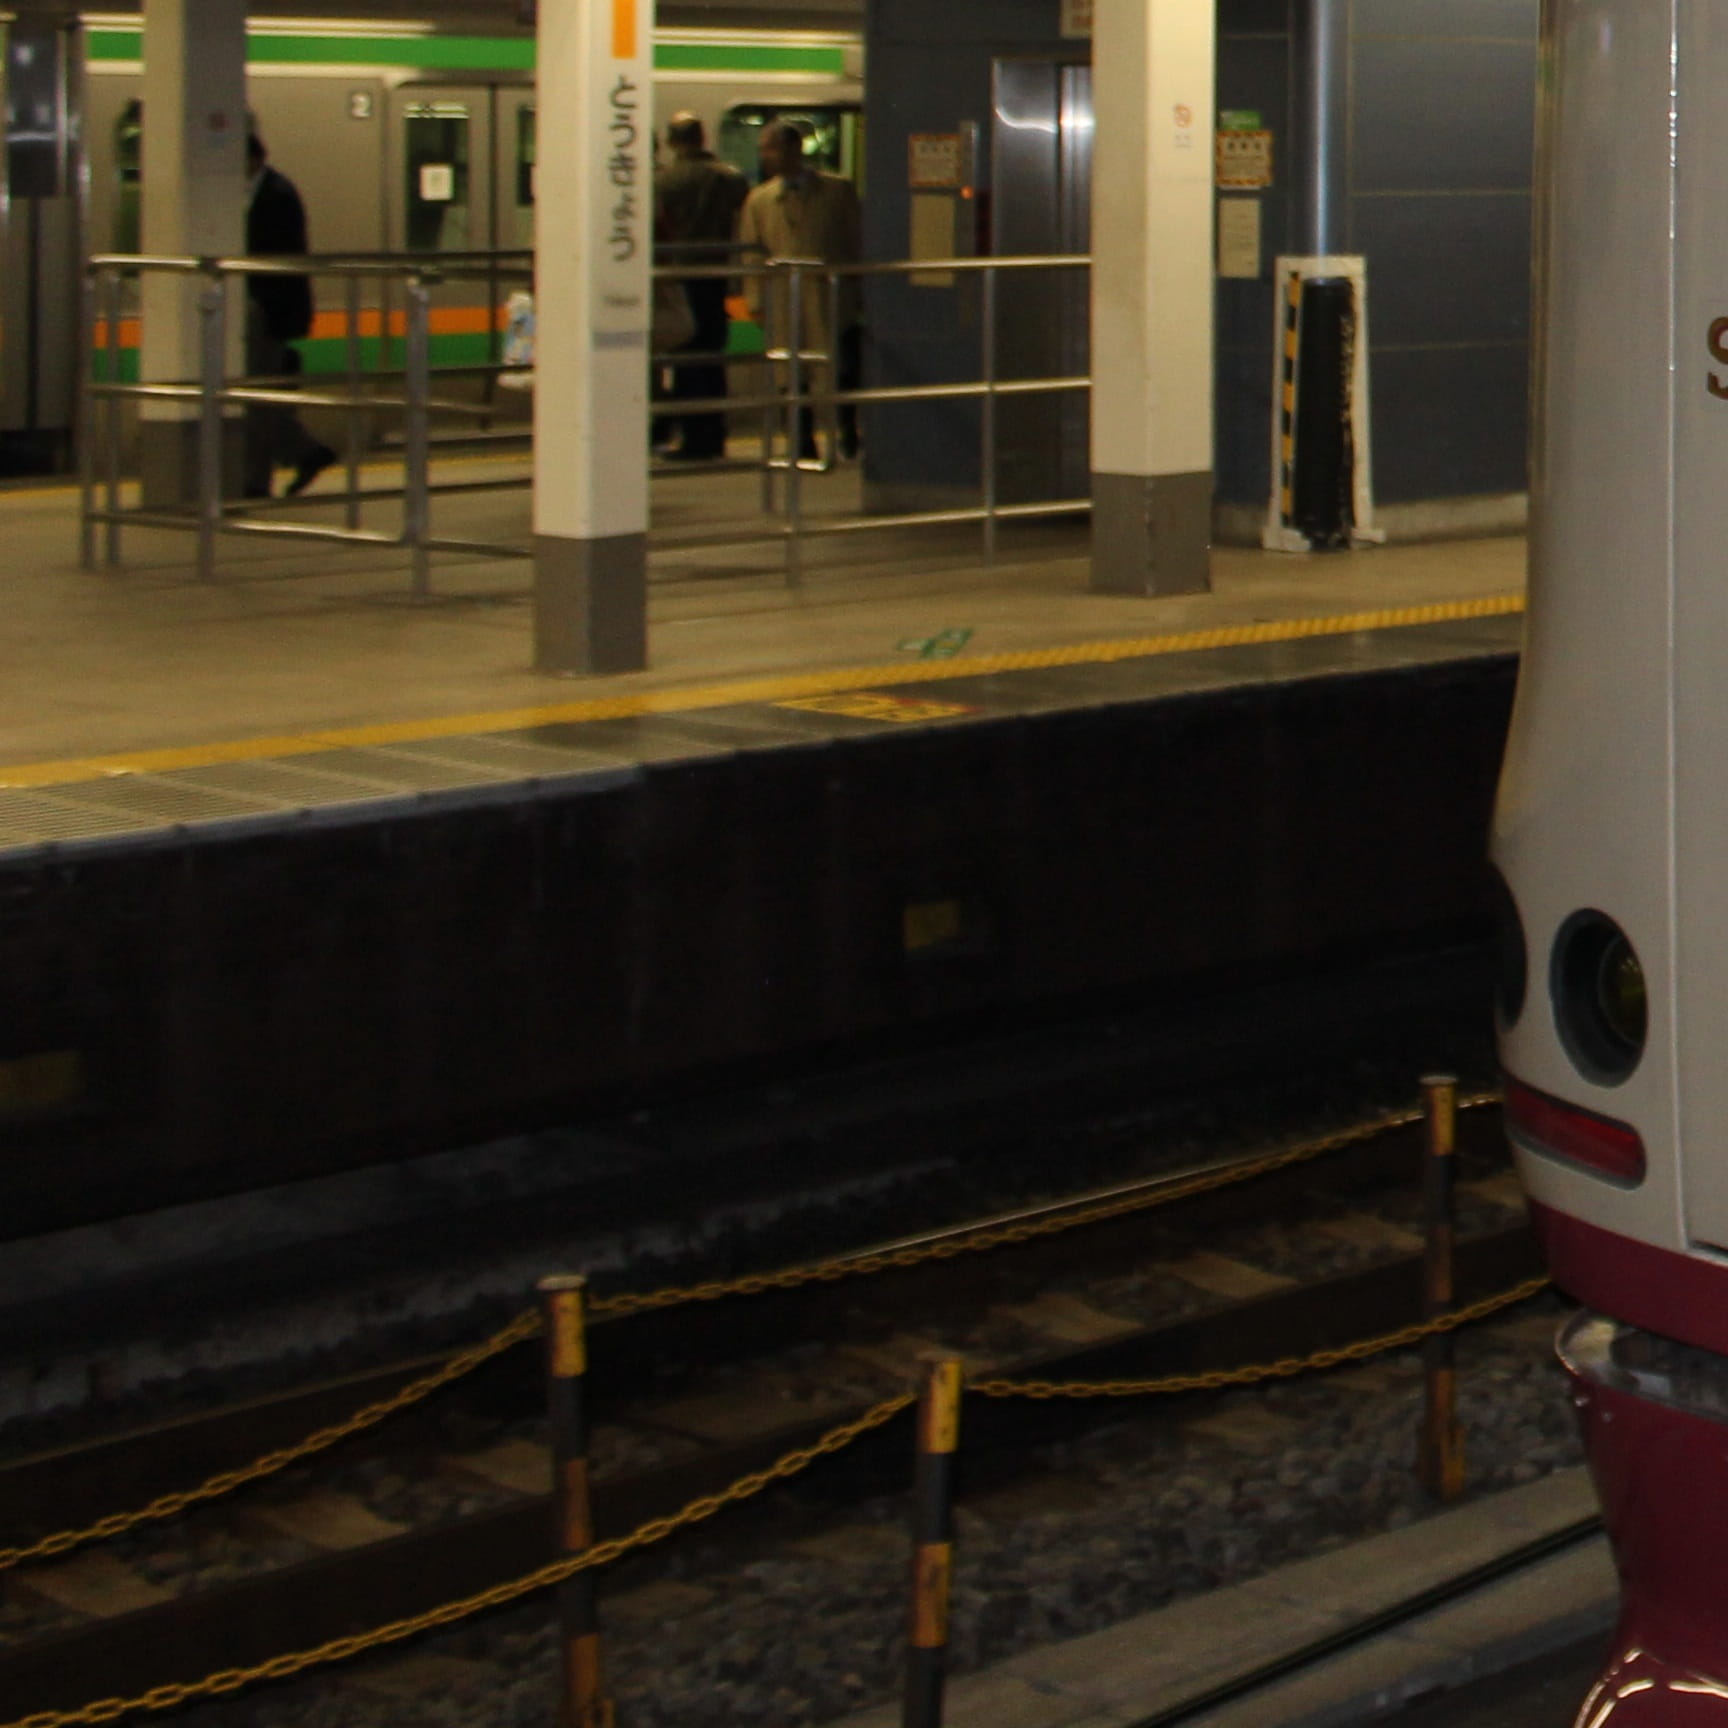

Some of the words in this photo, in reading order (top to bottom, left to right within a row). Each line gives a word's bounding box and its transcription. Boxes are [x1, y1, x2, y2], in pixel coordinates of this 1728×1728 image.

[609, 75, 639, 262] とうきょう
